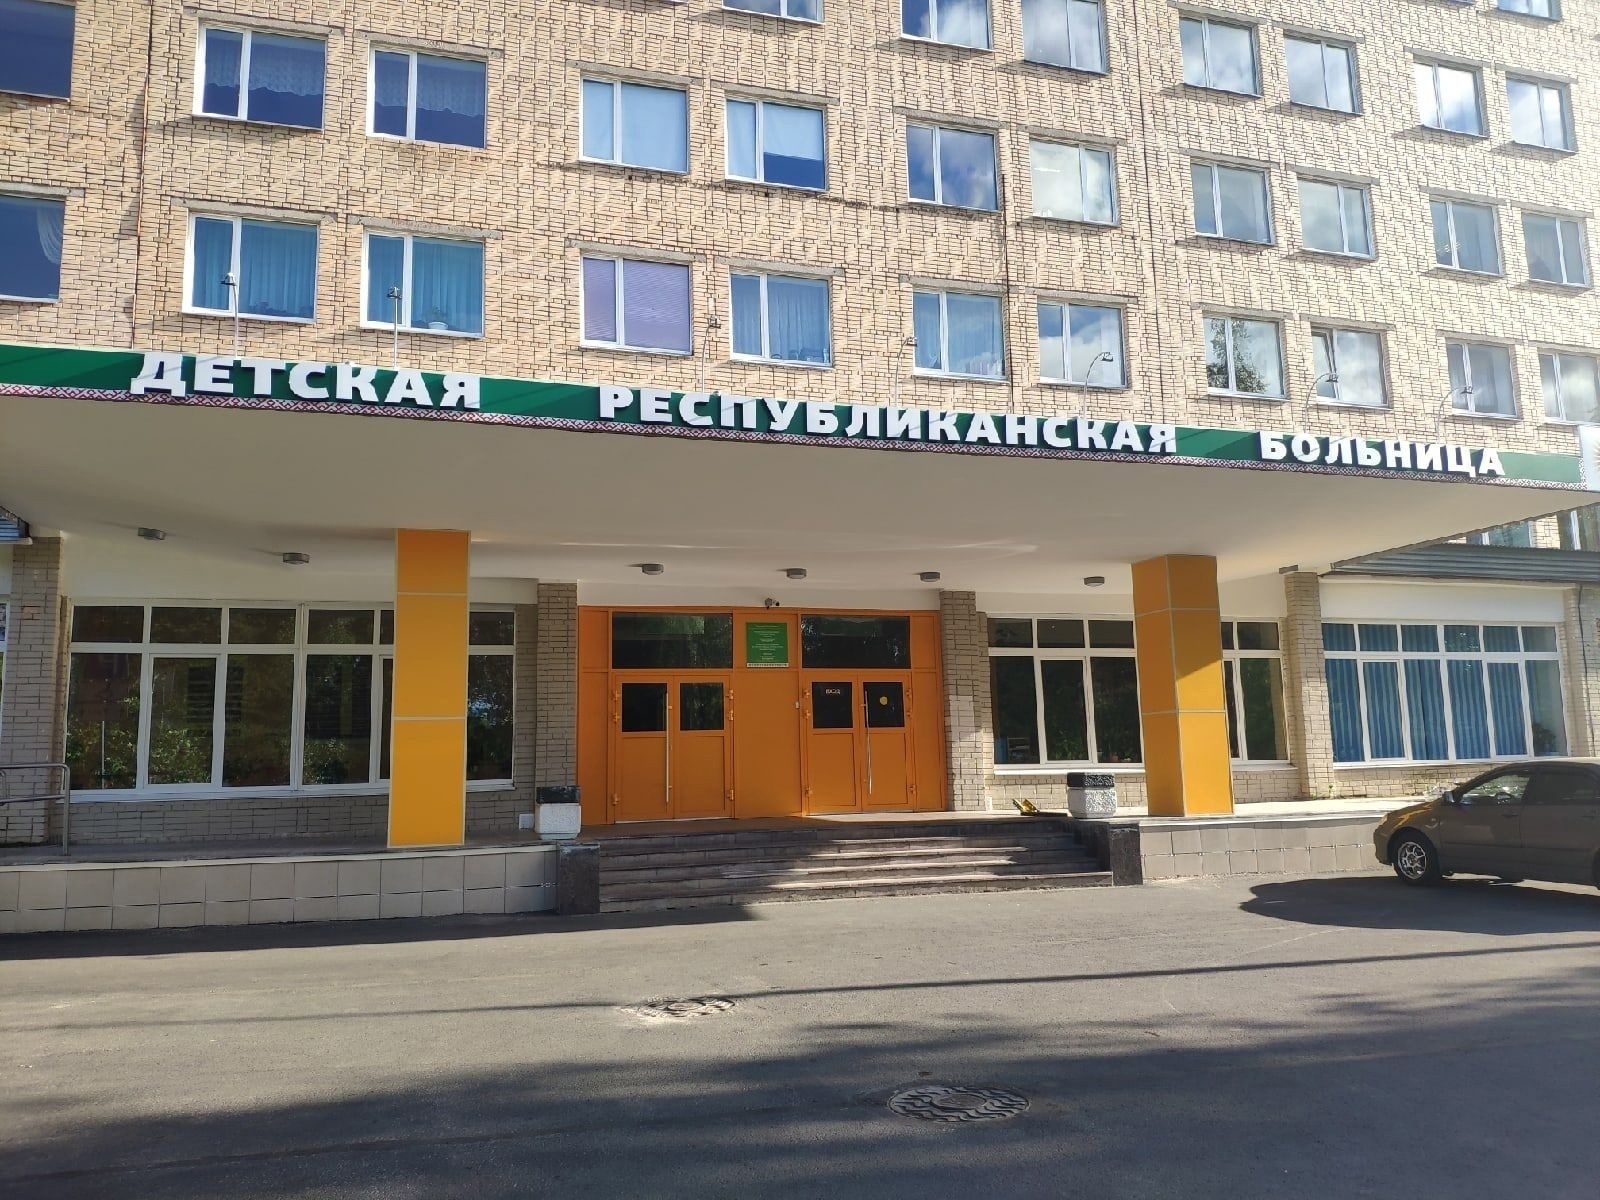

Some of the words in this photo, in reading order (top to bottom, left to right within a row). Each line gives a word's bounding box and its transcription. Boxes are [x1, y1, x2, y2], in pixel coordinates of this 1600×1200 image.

[131, 353, 481, 409] ДЕТСКАЯ
[599, 386, 1177, 453] РЕСПУБЛИКАНСКАЯ
[1259, 431, 1505, 478] БОЛЬНИЦА
